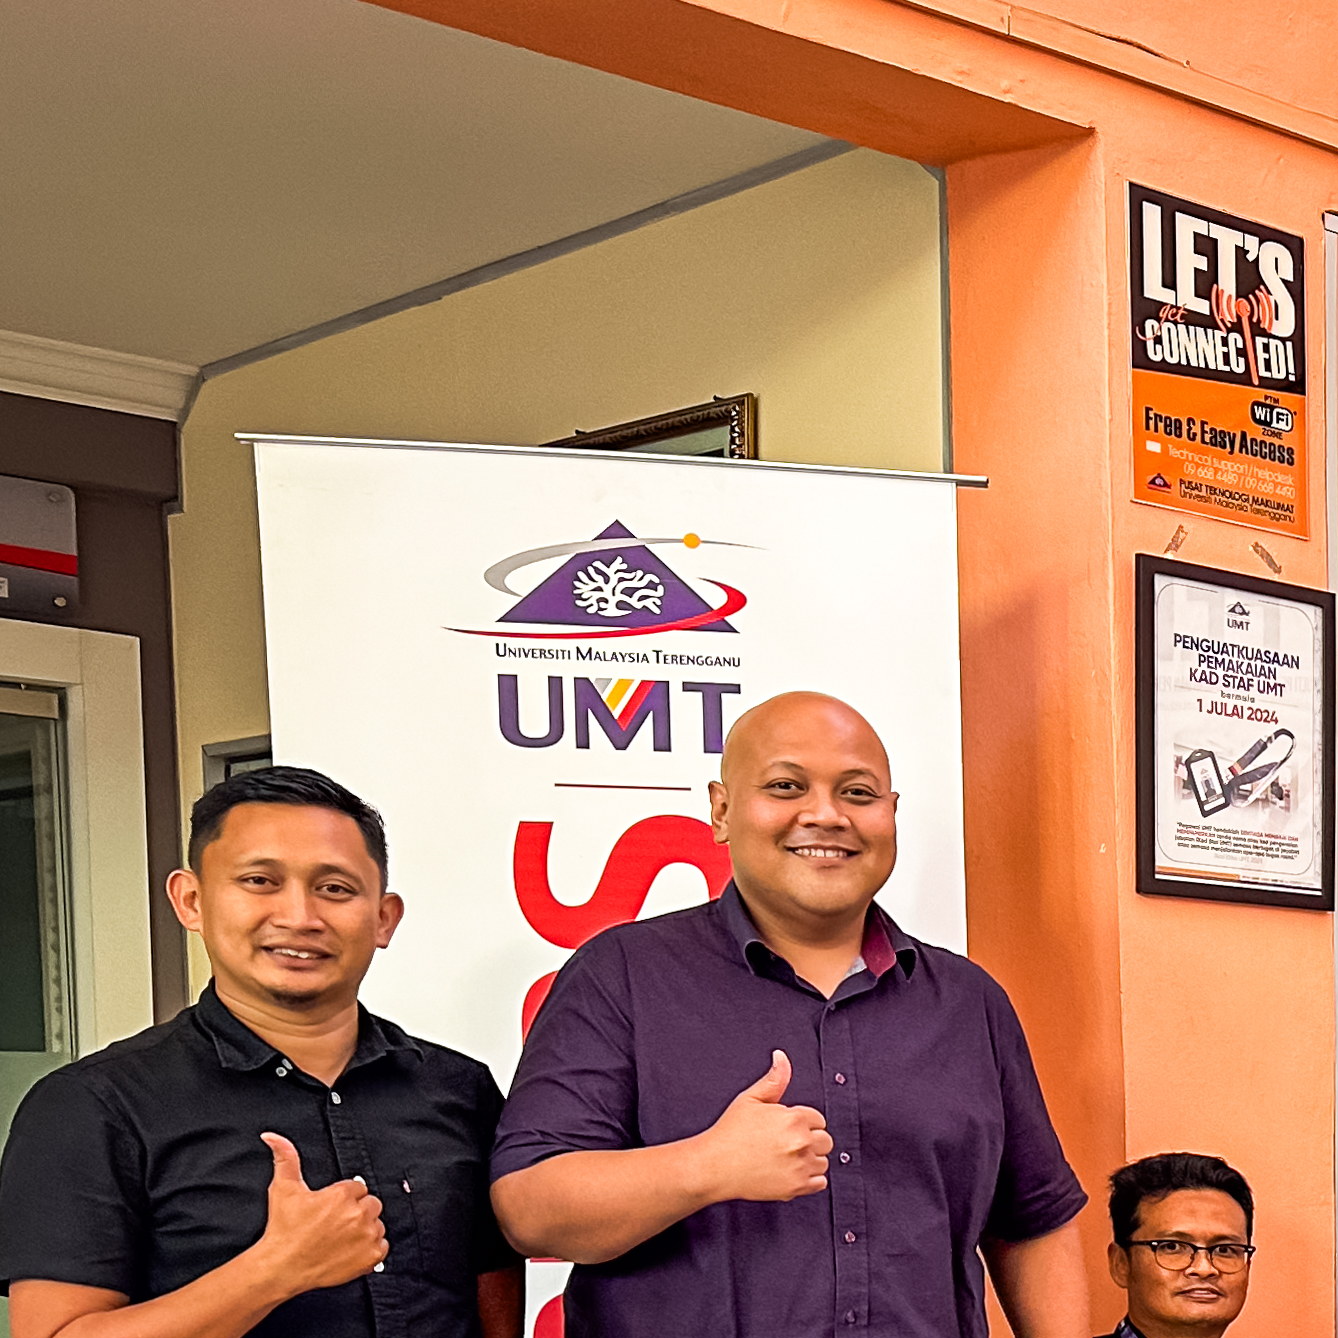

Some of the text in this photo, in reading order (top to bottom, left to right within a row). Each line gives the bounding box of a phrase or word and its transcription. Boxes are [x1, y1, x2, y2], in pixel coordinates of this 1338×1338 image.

[1142, 200, 1296, 338] LET'S
[1144, 406, 1296, 467] Free & Easy Access
[1168, 443, 1212, 465] Technical
[1180, 477, 1203, 493] PUSAT
[1184, 461, 1196, 475] 09
[1197, 464, 1215, 480] 668
[1245, 476, 1257, 489] 09
[1257, 479, 1274, 494] 668
[1227, 617, 1251, 631] UMT
[1173, 632, 1300, 670] PENGUATKUASAAN
[1189, 667, 1286, 698] KAD STAF UMT
[1198, 653, 1277, 681] PEMAKAIAN
[497, 673, 741, 754] UMT
[1197, 698, 1279, 725] 1 JULAI 2024
